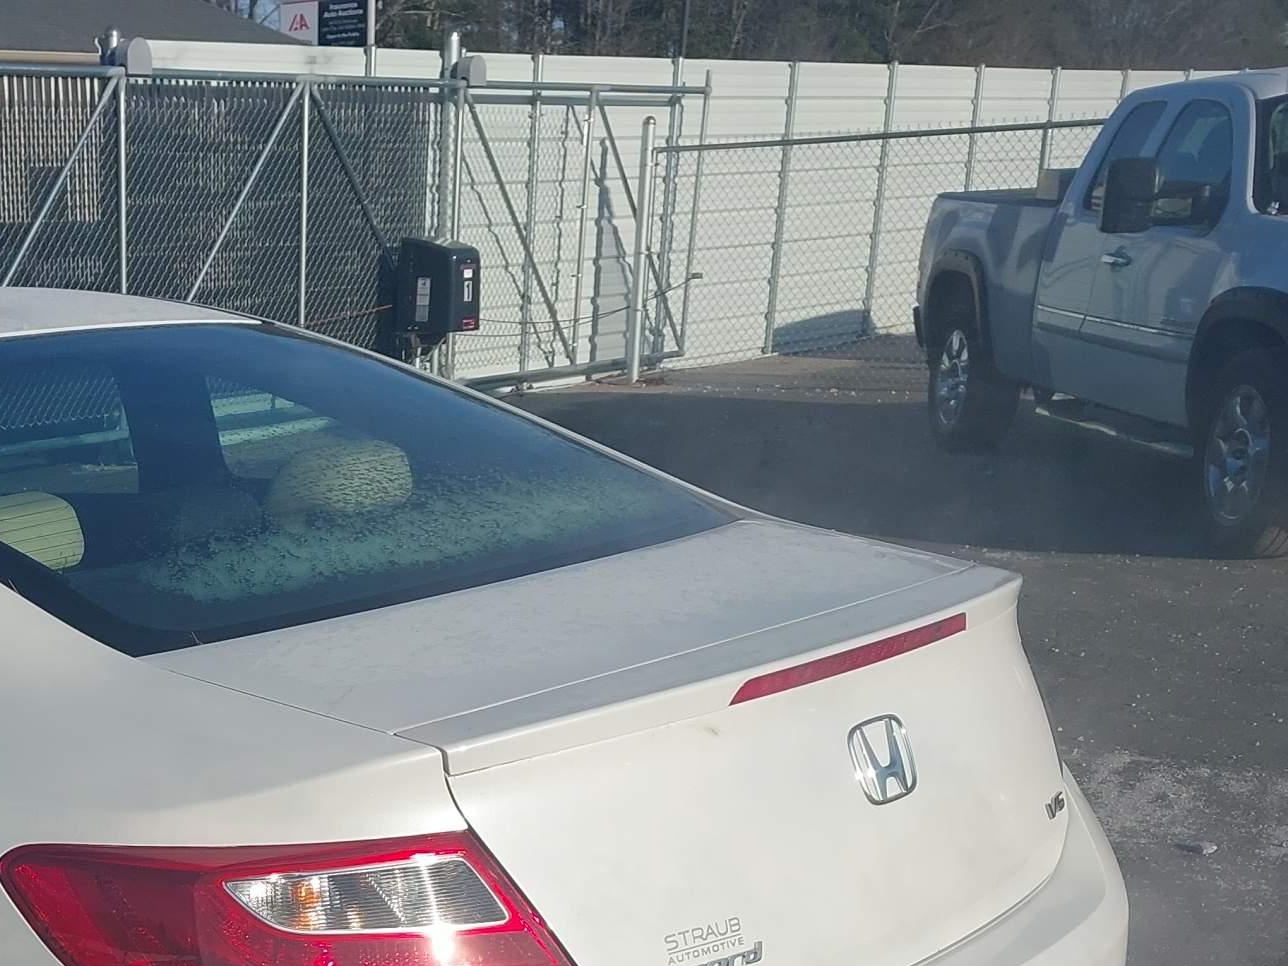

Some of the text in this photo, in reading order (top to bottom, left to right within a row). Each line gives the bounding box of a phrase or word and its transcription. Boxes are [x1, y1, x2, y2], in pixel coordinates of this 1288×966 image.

[1045, 791, 1065, 820] V6
[664, 917, 741, 951] STRAUB
[668, 937, 744, 965] AUTOMOTIVE
